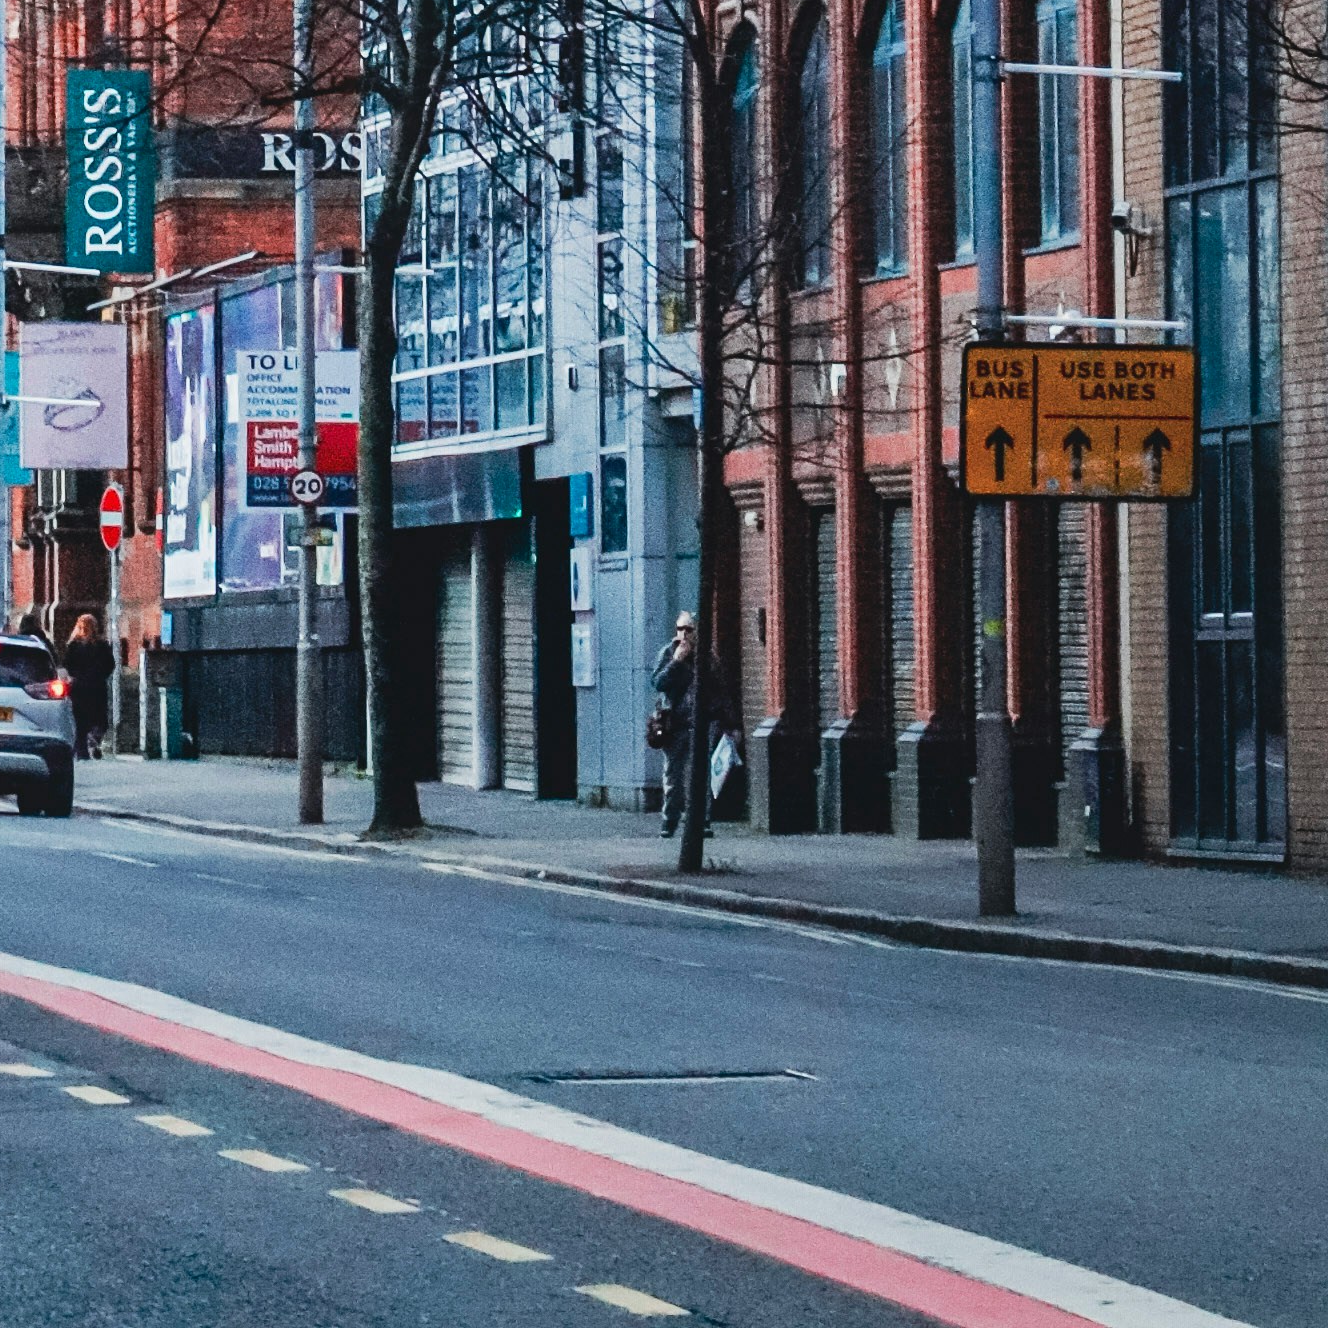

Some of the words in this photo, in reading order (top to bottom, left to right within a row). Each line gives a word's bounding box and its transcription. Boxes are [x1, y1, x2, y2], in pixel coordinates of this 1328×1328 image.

[260, 131, 362, 172] ROS
[83, 87, 122, 256] ROSS'S
[246, 355, 276, 370] TO
[976, 359, 1024, 378] BUS
[1060, 361, 1105, 379] USE
[1115, 362, 1176, 379] BOTH
[247, 373, 282, 382] OFFICE
[247, 385, 351, 394] ACCOMMATION
[970, 381, 1030, 400] LANE
[1080, 383, 1156, 401] LANES
[254, 425, 300, 439] Lambe
[254, 440, 292, 454] Smith
[254, 454, 300, 471] Hampt
[294, 478, 322, 495] 20
